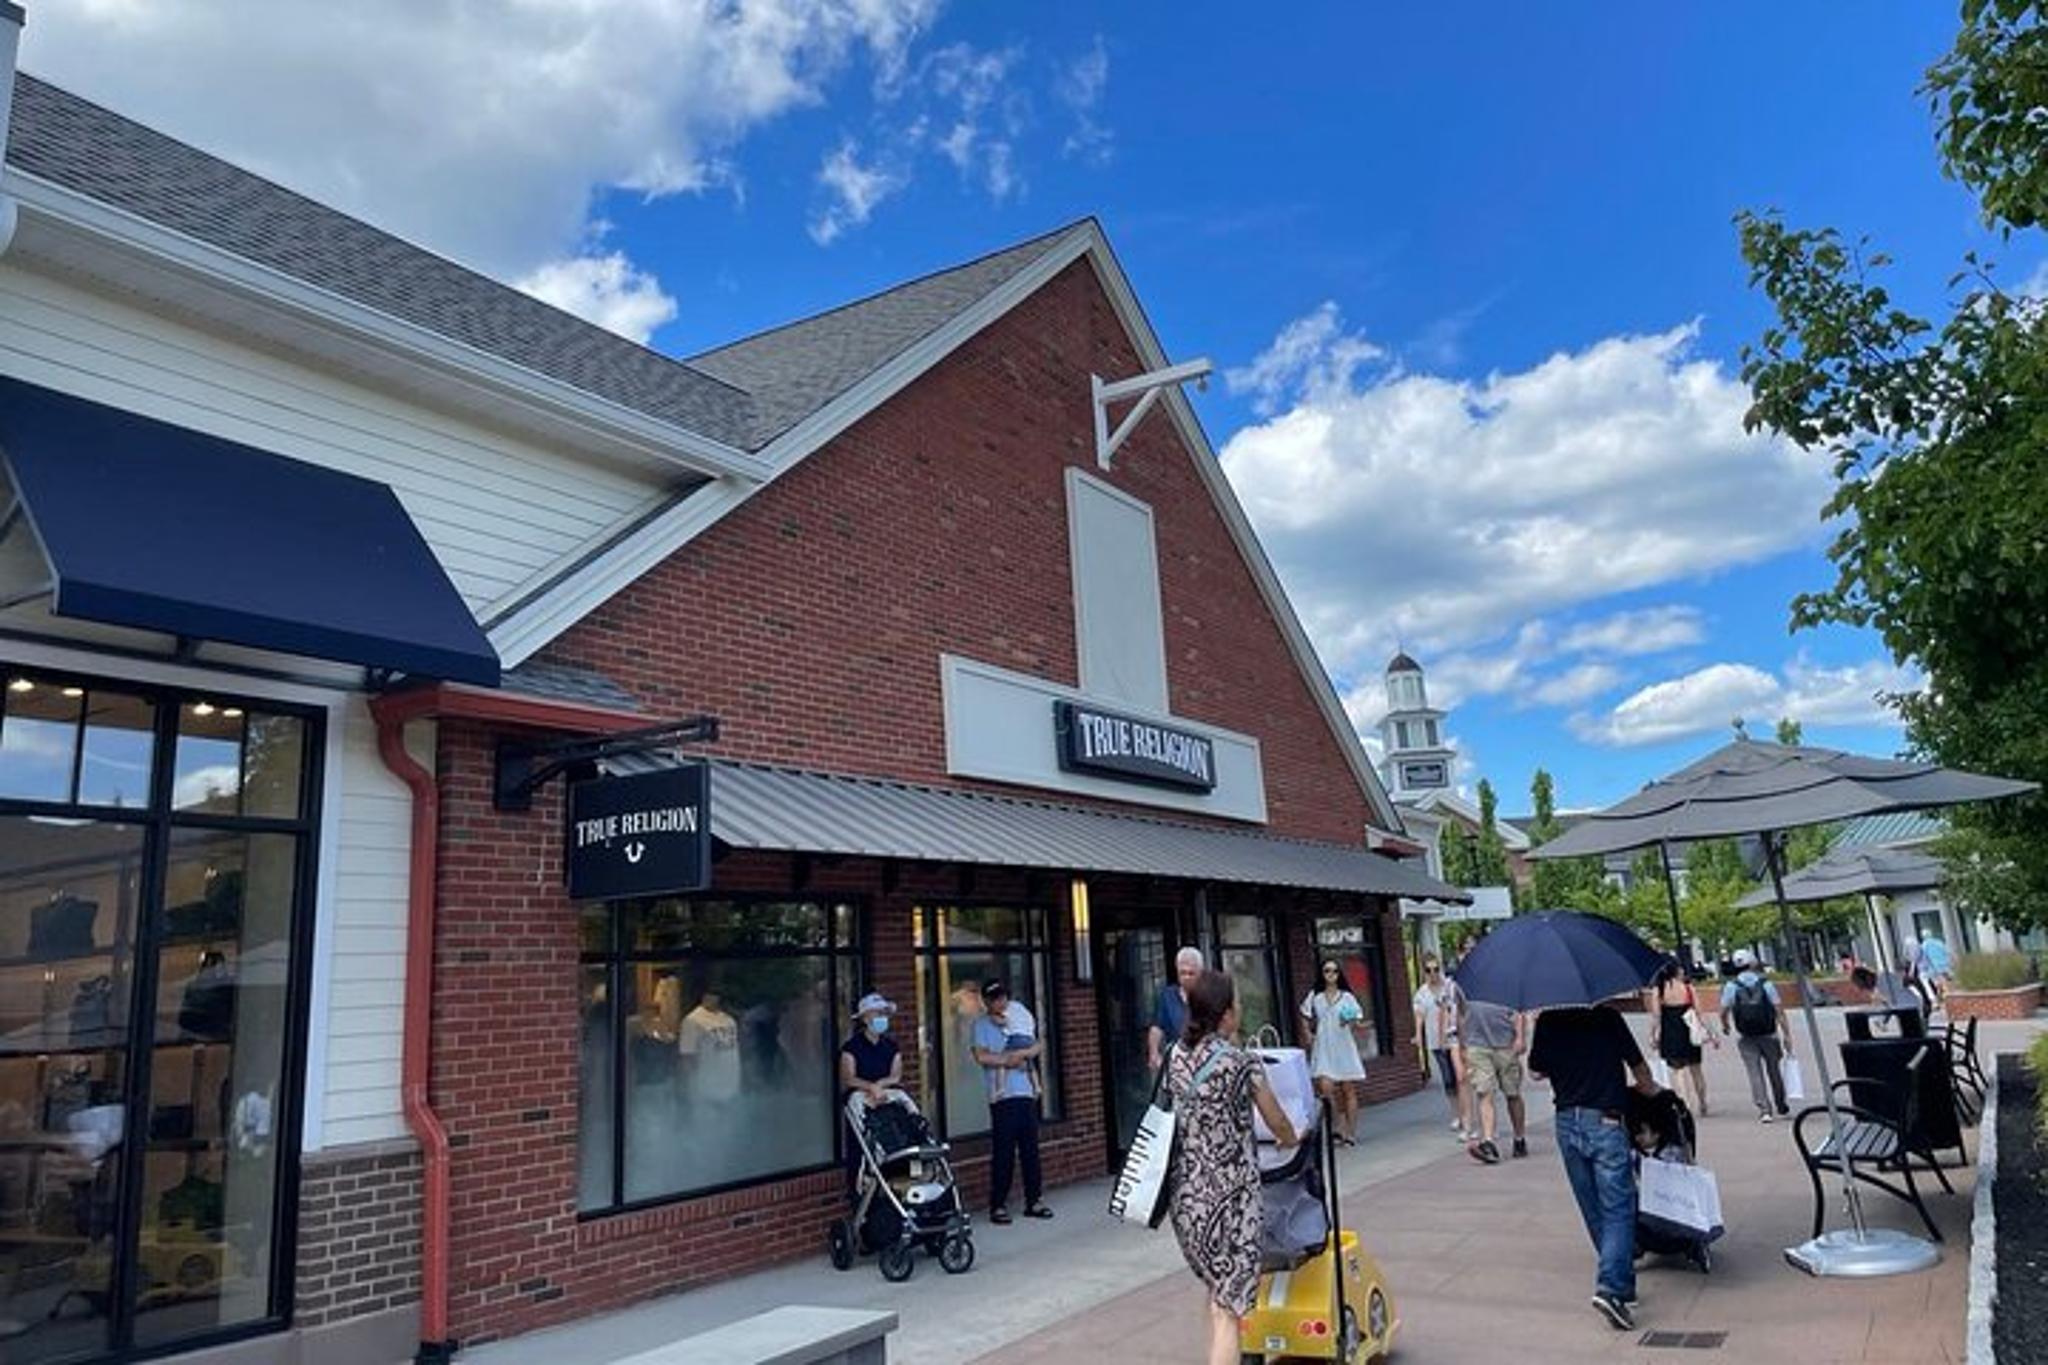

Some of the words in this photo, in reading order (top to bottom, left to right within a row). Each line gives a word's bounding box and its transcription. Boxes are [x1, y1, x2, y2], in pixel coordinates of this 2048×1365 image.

[1078, 713, 1131, 757] TRUE
[1132, 724, 1210, 781] RELIGION
[575, 816, 618, 848] TRUE
[621, 807, 698, 835] RELIGION
